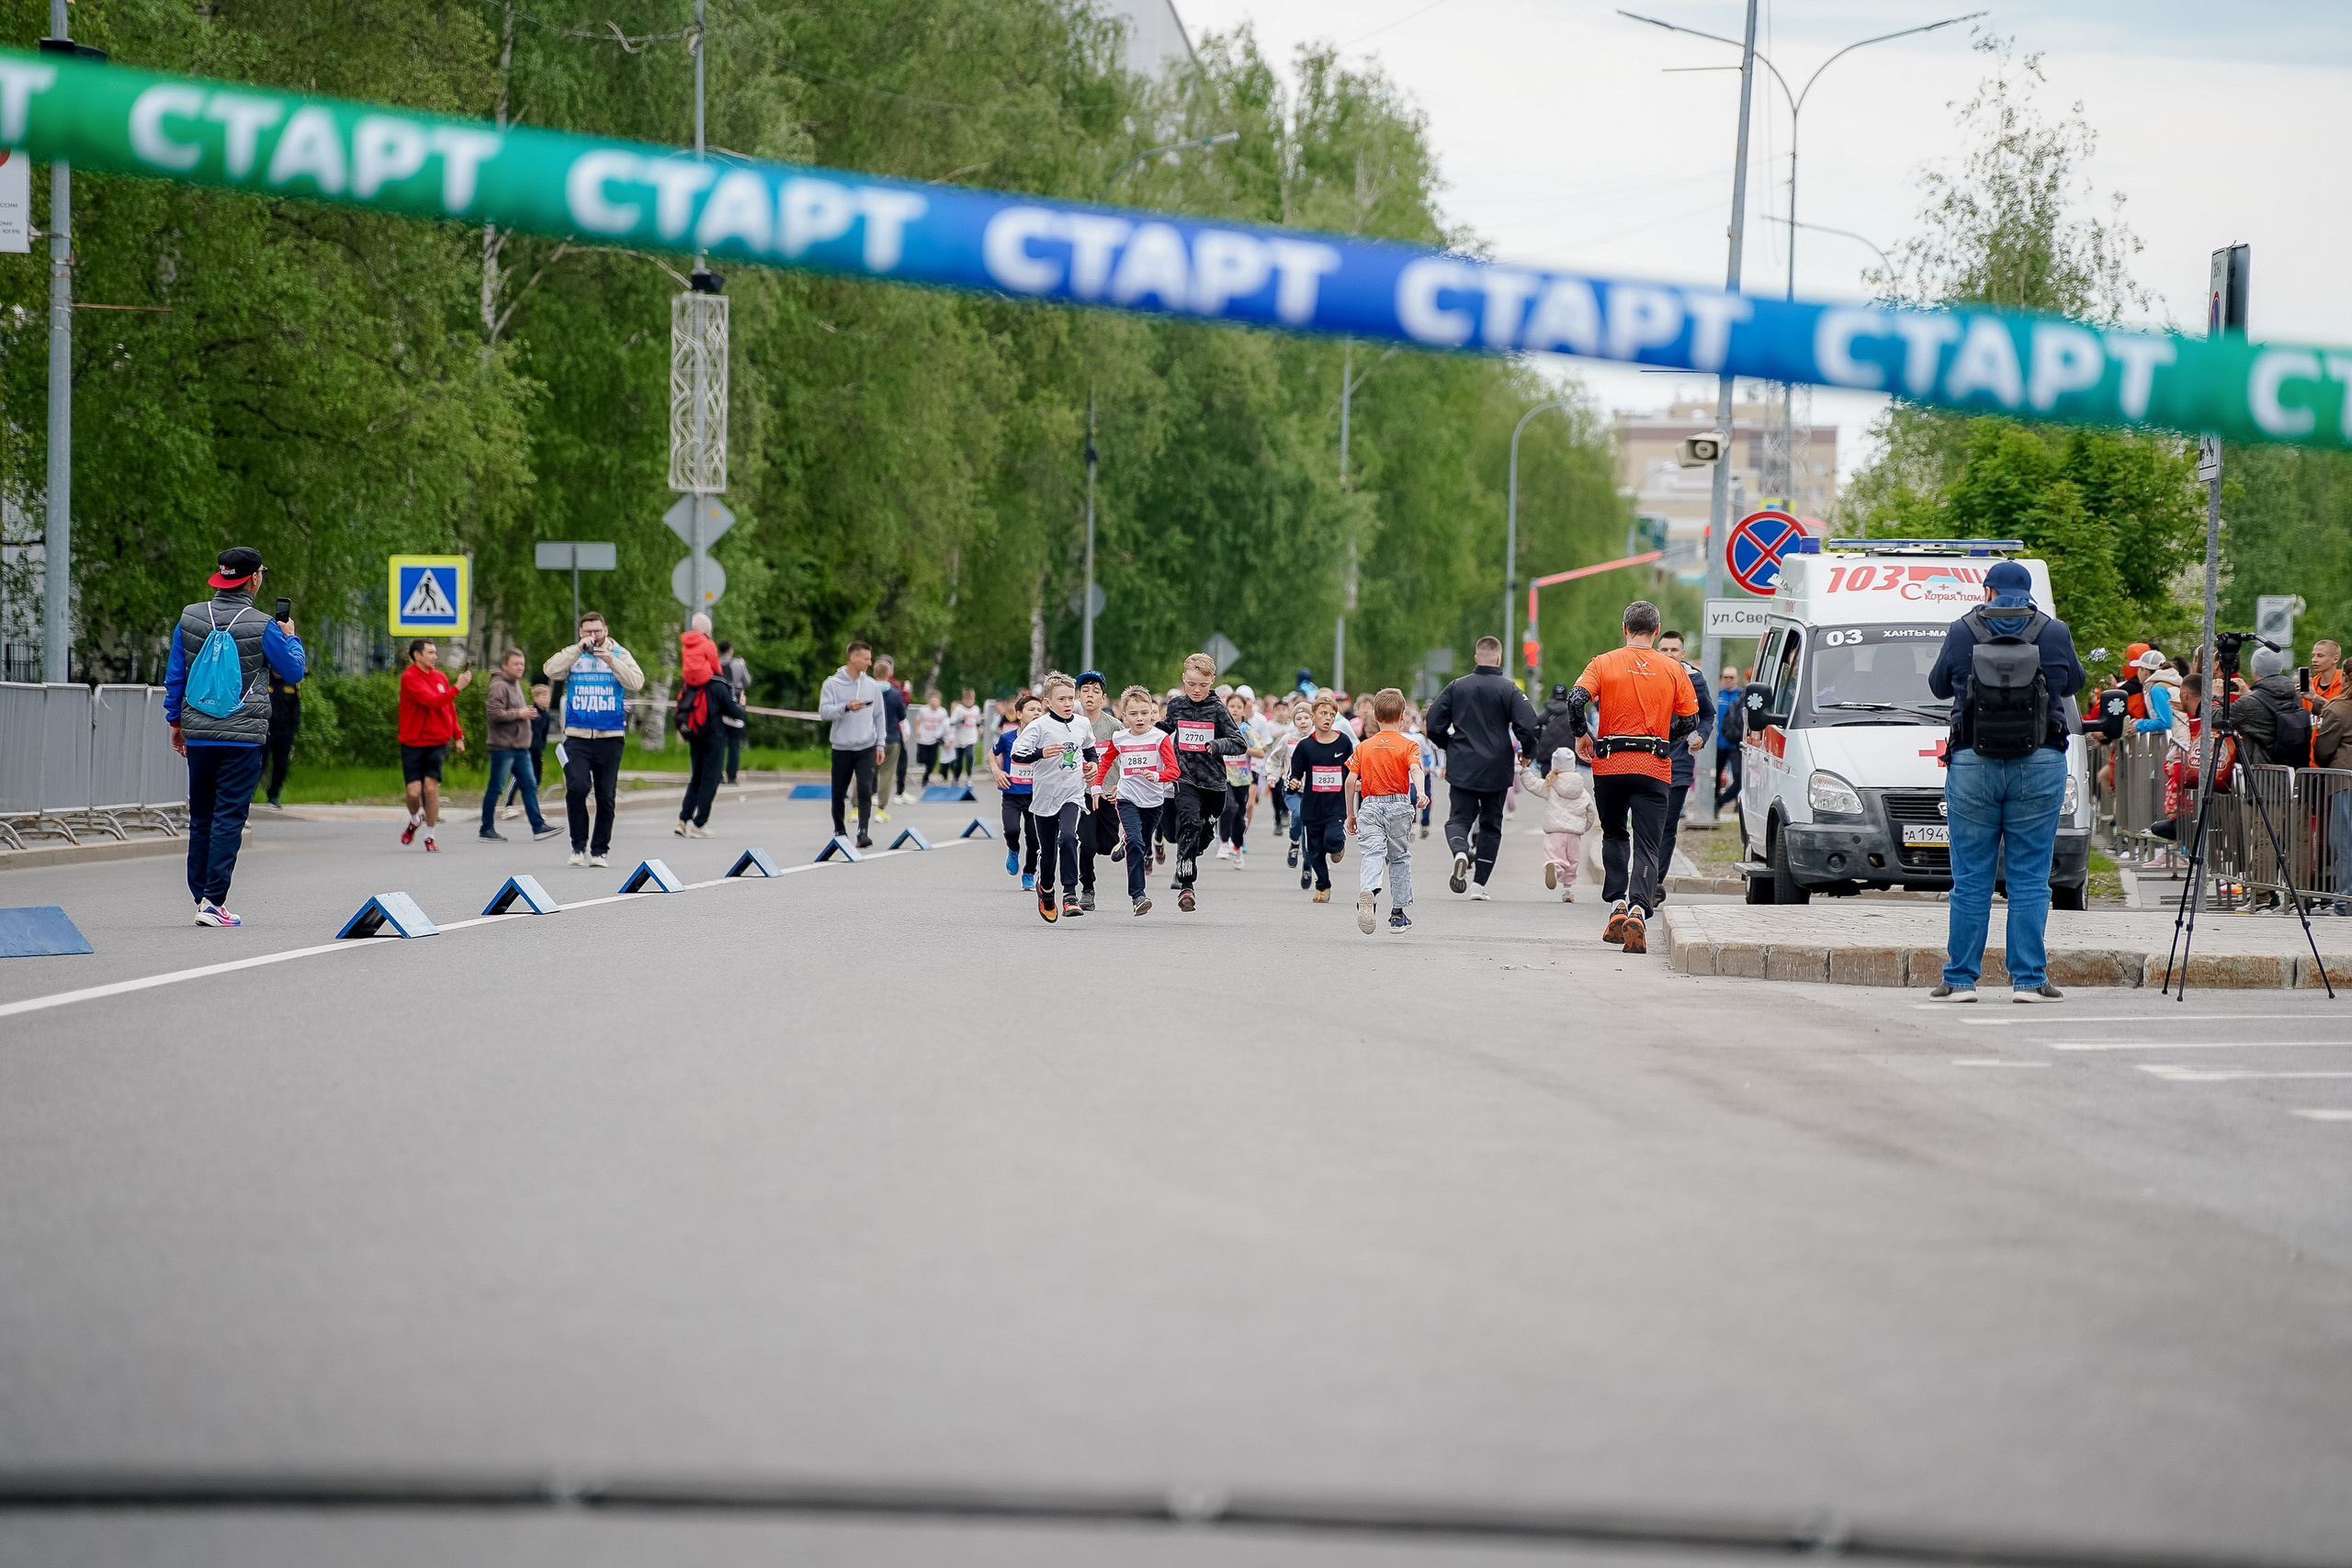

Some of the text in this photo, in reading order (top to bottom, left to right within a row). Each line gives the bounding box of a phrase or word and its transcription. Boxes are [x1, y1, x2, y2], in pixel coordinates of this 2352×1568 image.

[129, 84, 502, 215] СТАРТ
[566, 149, 929, 273] СТАРТ
[983, 207, 1342, 326] СТАРТ
[1395, 258, 1754, 372] СТАРТ
[1814, 310, 2177, 420] СТАРТ
[1826, 565, 1905, 593] 103
[1900, 582, 1957, 604] Скорая
[1826, 629, 1863, 646] 03
[1883, 629, 1947, 637] ХАНТЫ-МА
[574, 684, 614, 695] ГЛАВНЫЙ
[571, 695, 616, 713] СУДЬЯ
[1127, 757, 1148, 765] 2882
